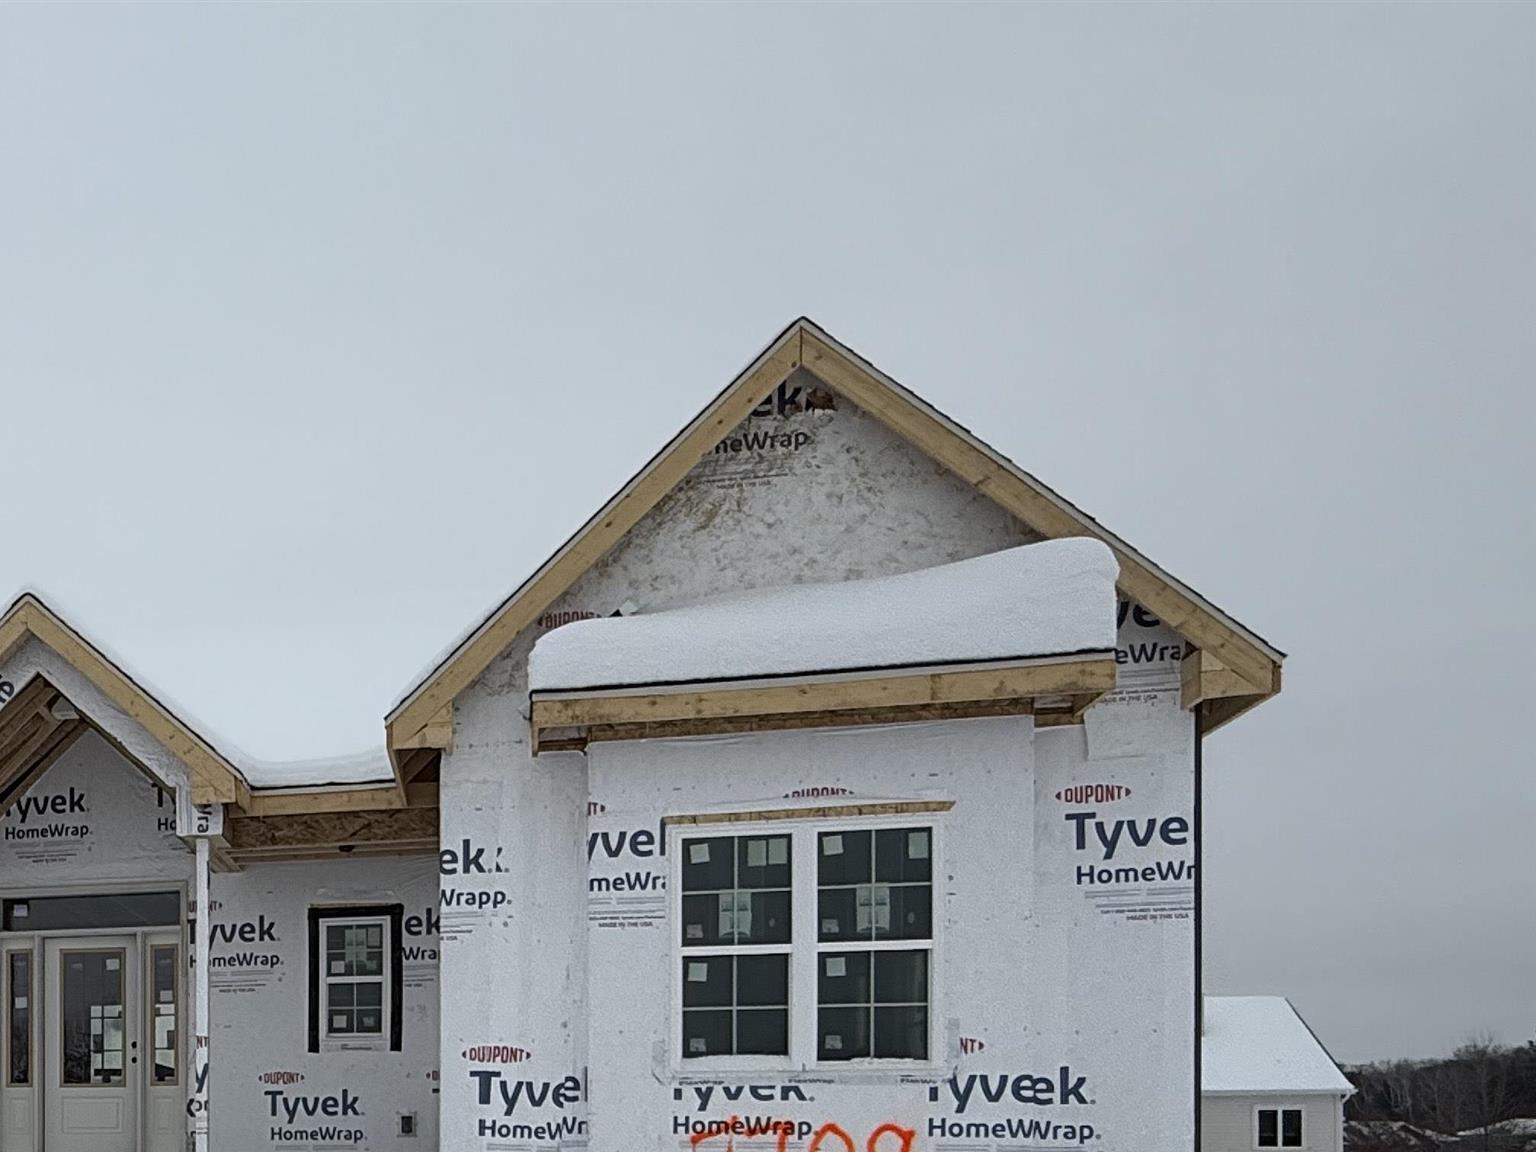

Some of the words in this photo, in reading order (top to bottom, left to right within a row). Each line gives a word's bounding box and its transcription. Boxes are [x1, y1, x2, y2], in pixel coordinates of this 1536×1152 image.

[1064, 784, 1123, 804] DUPONT
[5, 823, 89, 841] HomeWrap
[1064, 812, 1189, 860] Tyve
[189, 952, 280, 969] HmeWrap
[469, 1066, 588, 1116] Tyve
[264, 1089, 360, 1124] Tyvek
[271, 1126, 364, 1144] HomeWrap
[673, 1116, 813, 1140] HomeWrap
